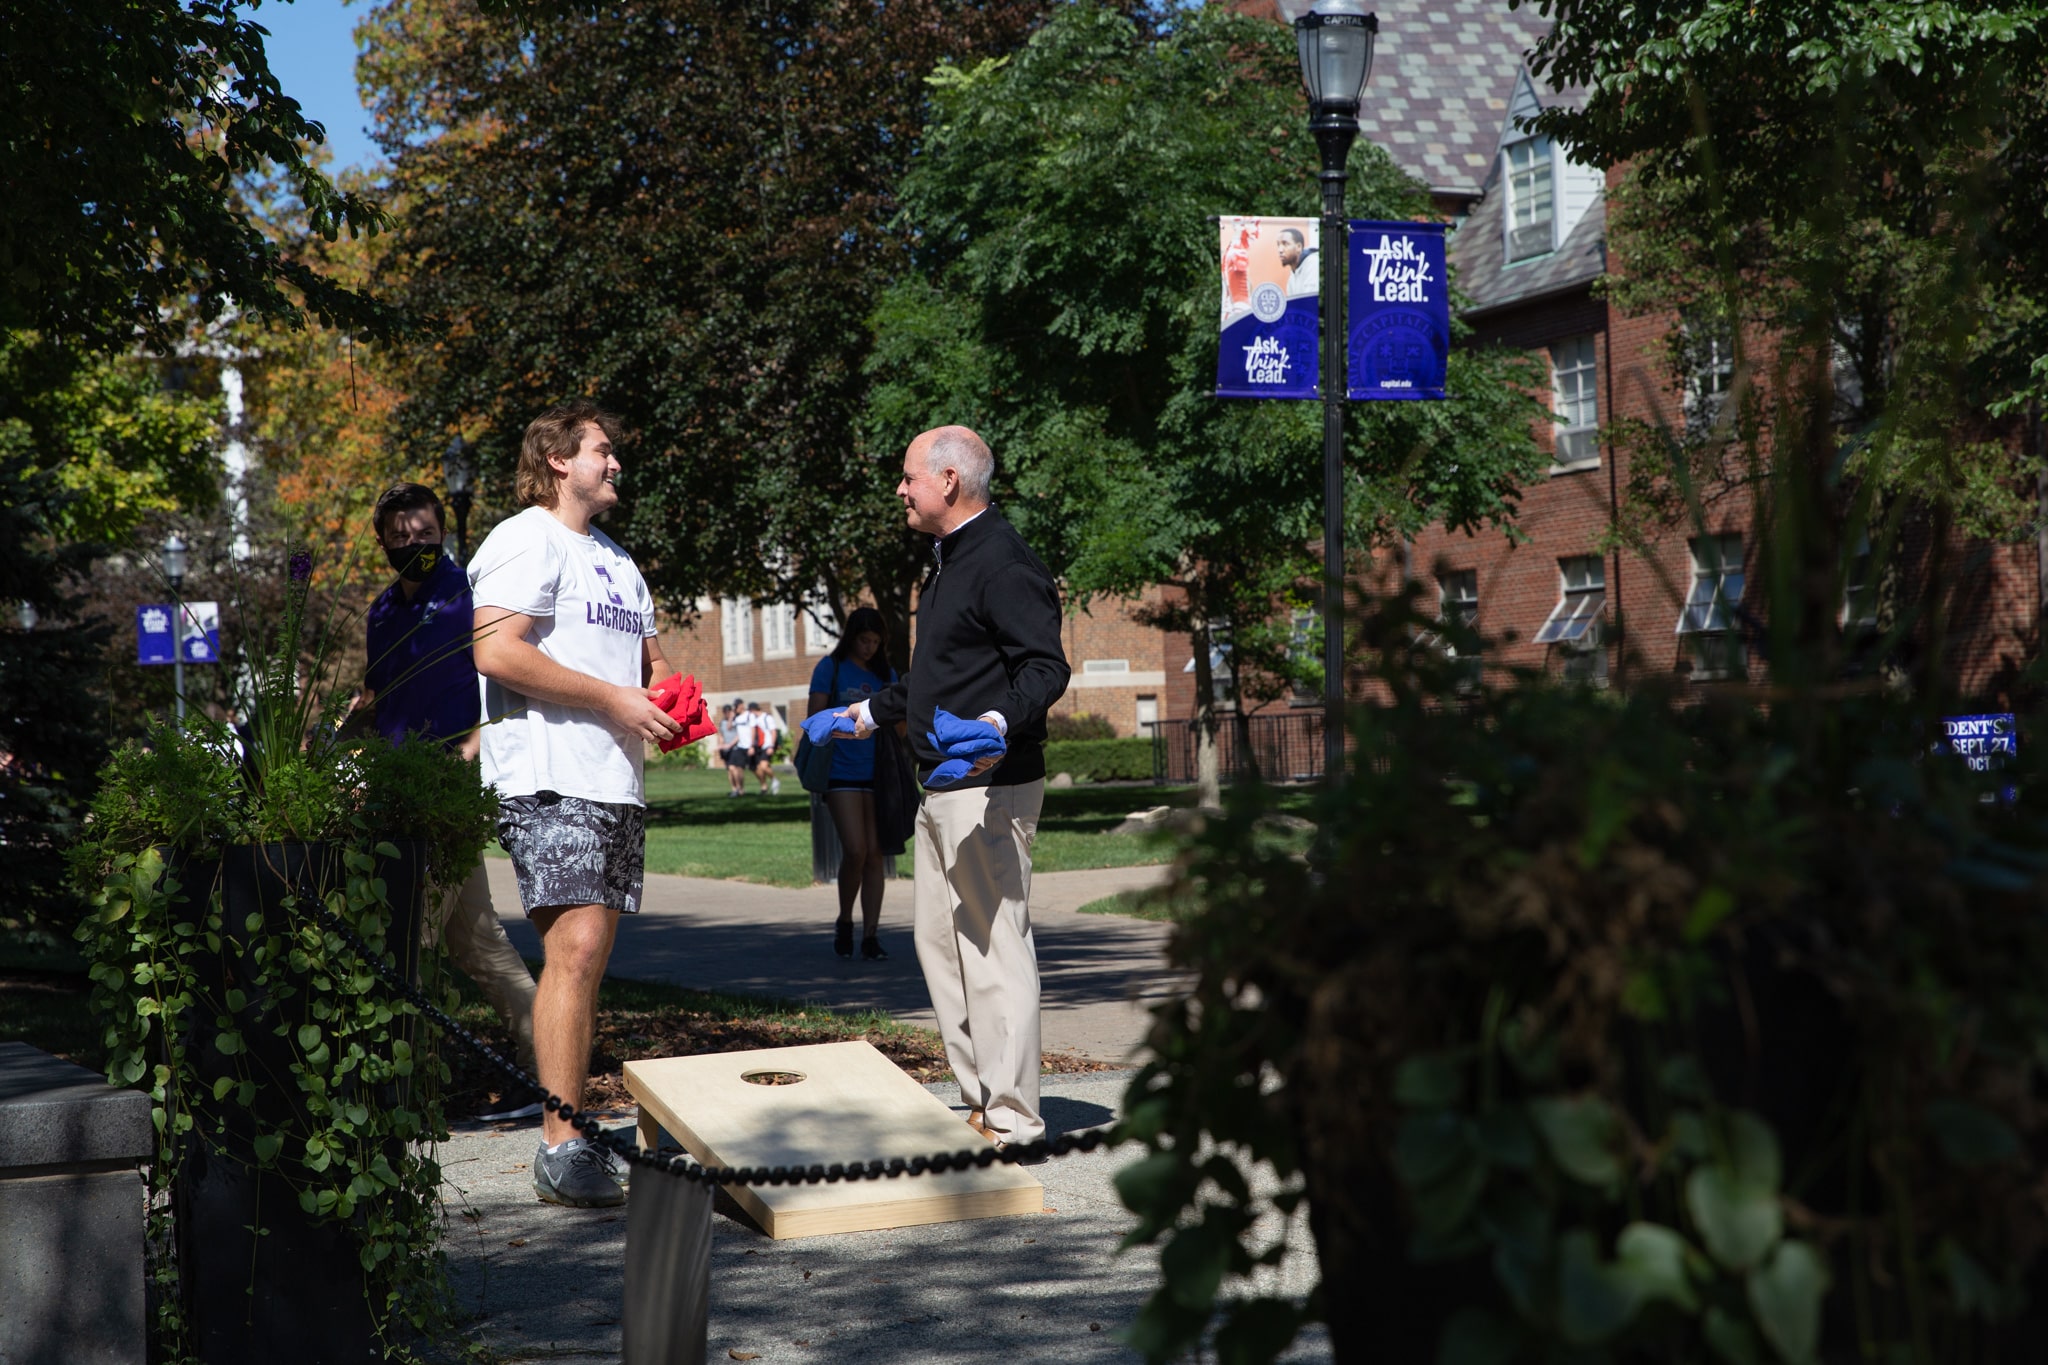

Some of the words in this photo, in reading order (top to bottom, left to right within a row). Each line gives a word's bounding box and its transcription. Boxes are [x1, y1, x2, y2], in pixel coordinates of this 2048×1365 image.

[1323, 15, 1363, 25] CAPITAL
[1379, 234, 1420, 262] Ask.
[1363, 248, 1434, 285] Think.
[1374, 277, 1429, 303] Lead.
[1254, 335, 1282, 354] Ask.
[1242, 345, 1291, 371] Think.
[1248, 367, 1287, 384] Lead.
[1951, 737, 1987, 755] SEPT.
[1990, 736, 2010, 753] 27
